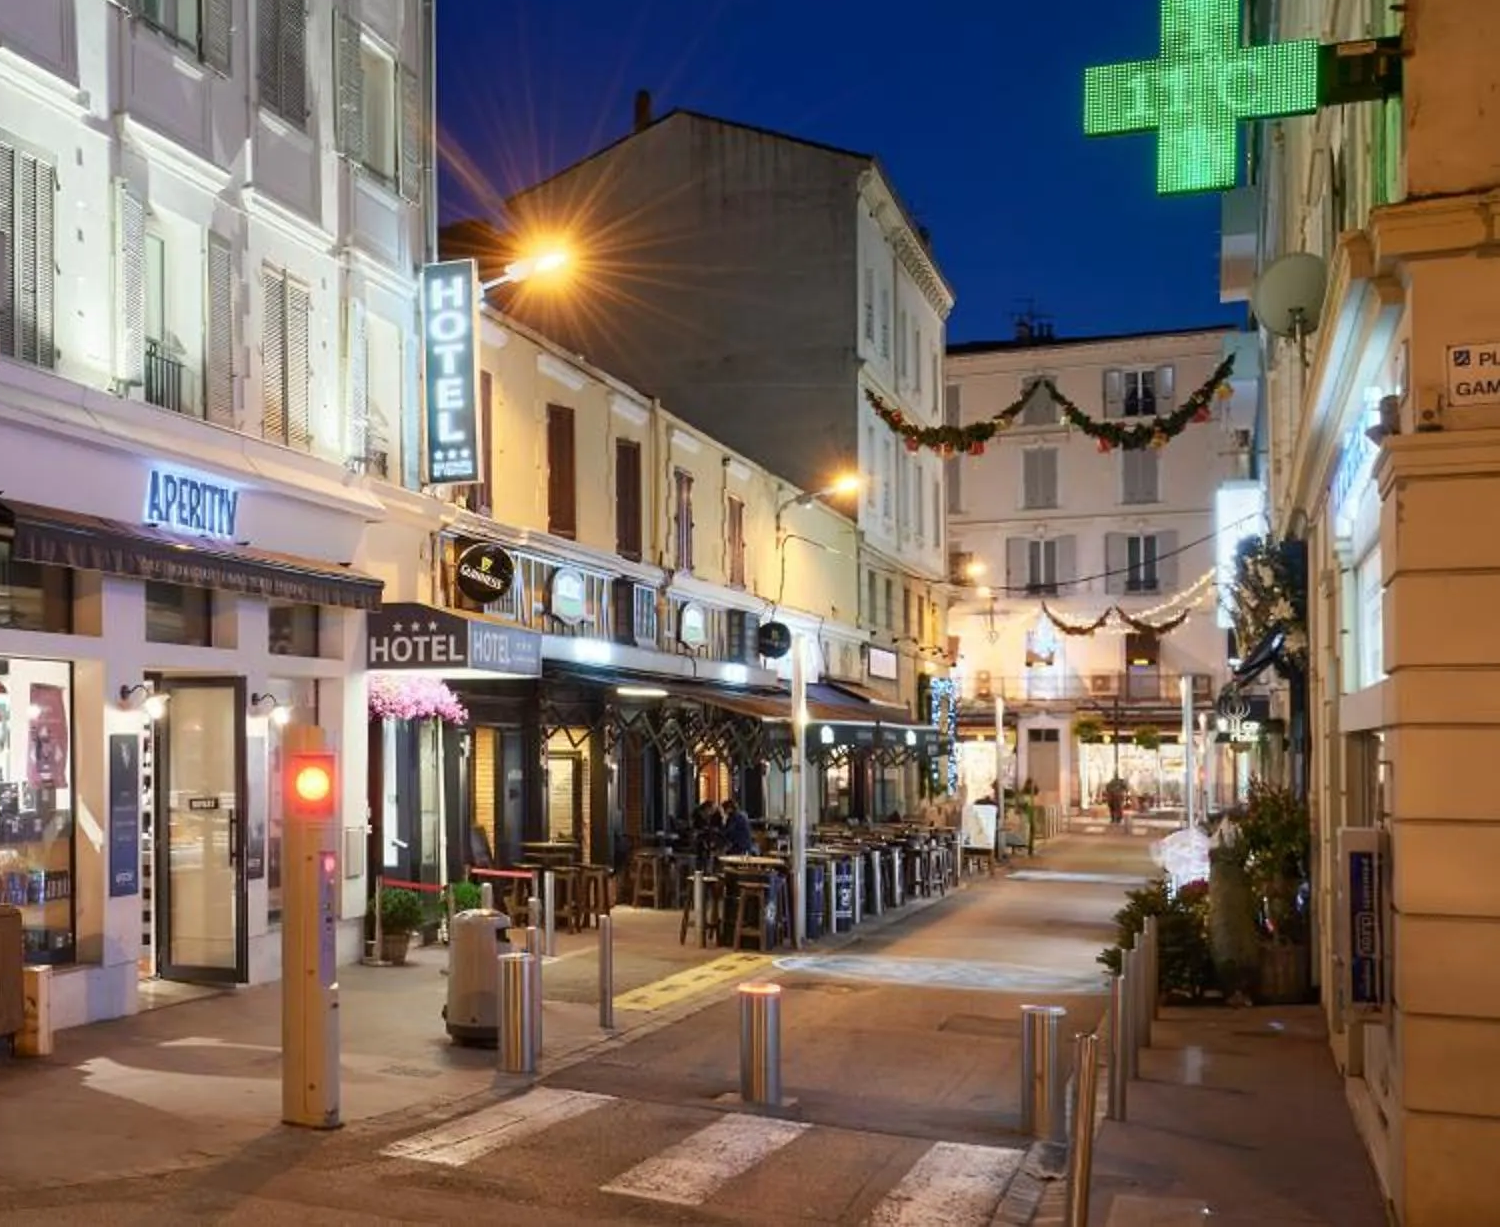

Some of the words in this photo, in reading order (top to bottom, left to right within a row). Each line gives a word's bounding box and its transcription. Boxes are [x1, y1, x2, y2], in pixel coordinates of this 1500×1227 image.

[429, 275, 468, 444] HOTEL
[148, 470, 238, 535] APERITIV
[459, 563, 504, 590] GUINNESS
[369, 635, 465, 662] HOTEL
[473, 630, 511, 663] HOTEL
